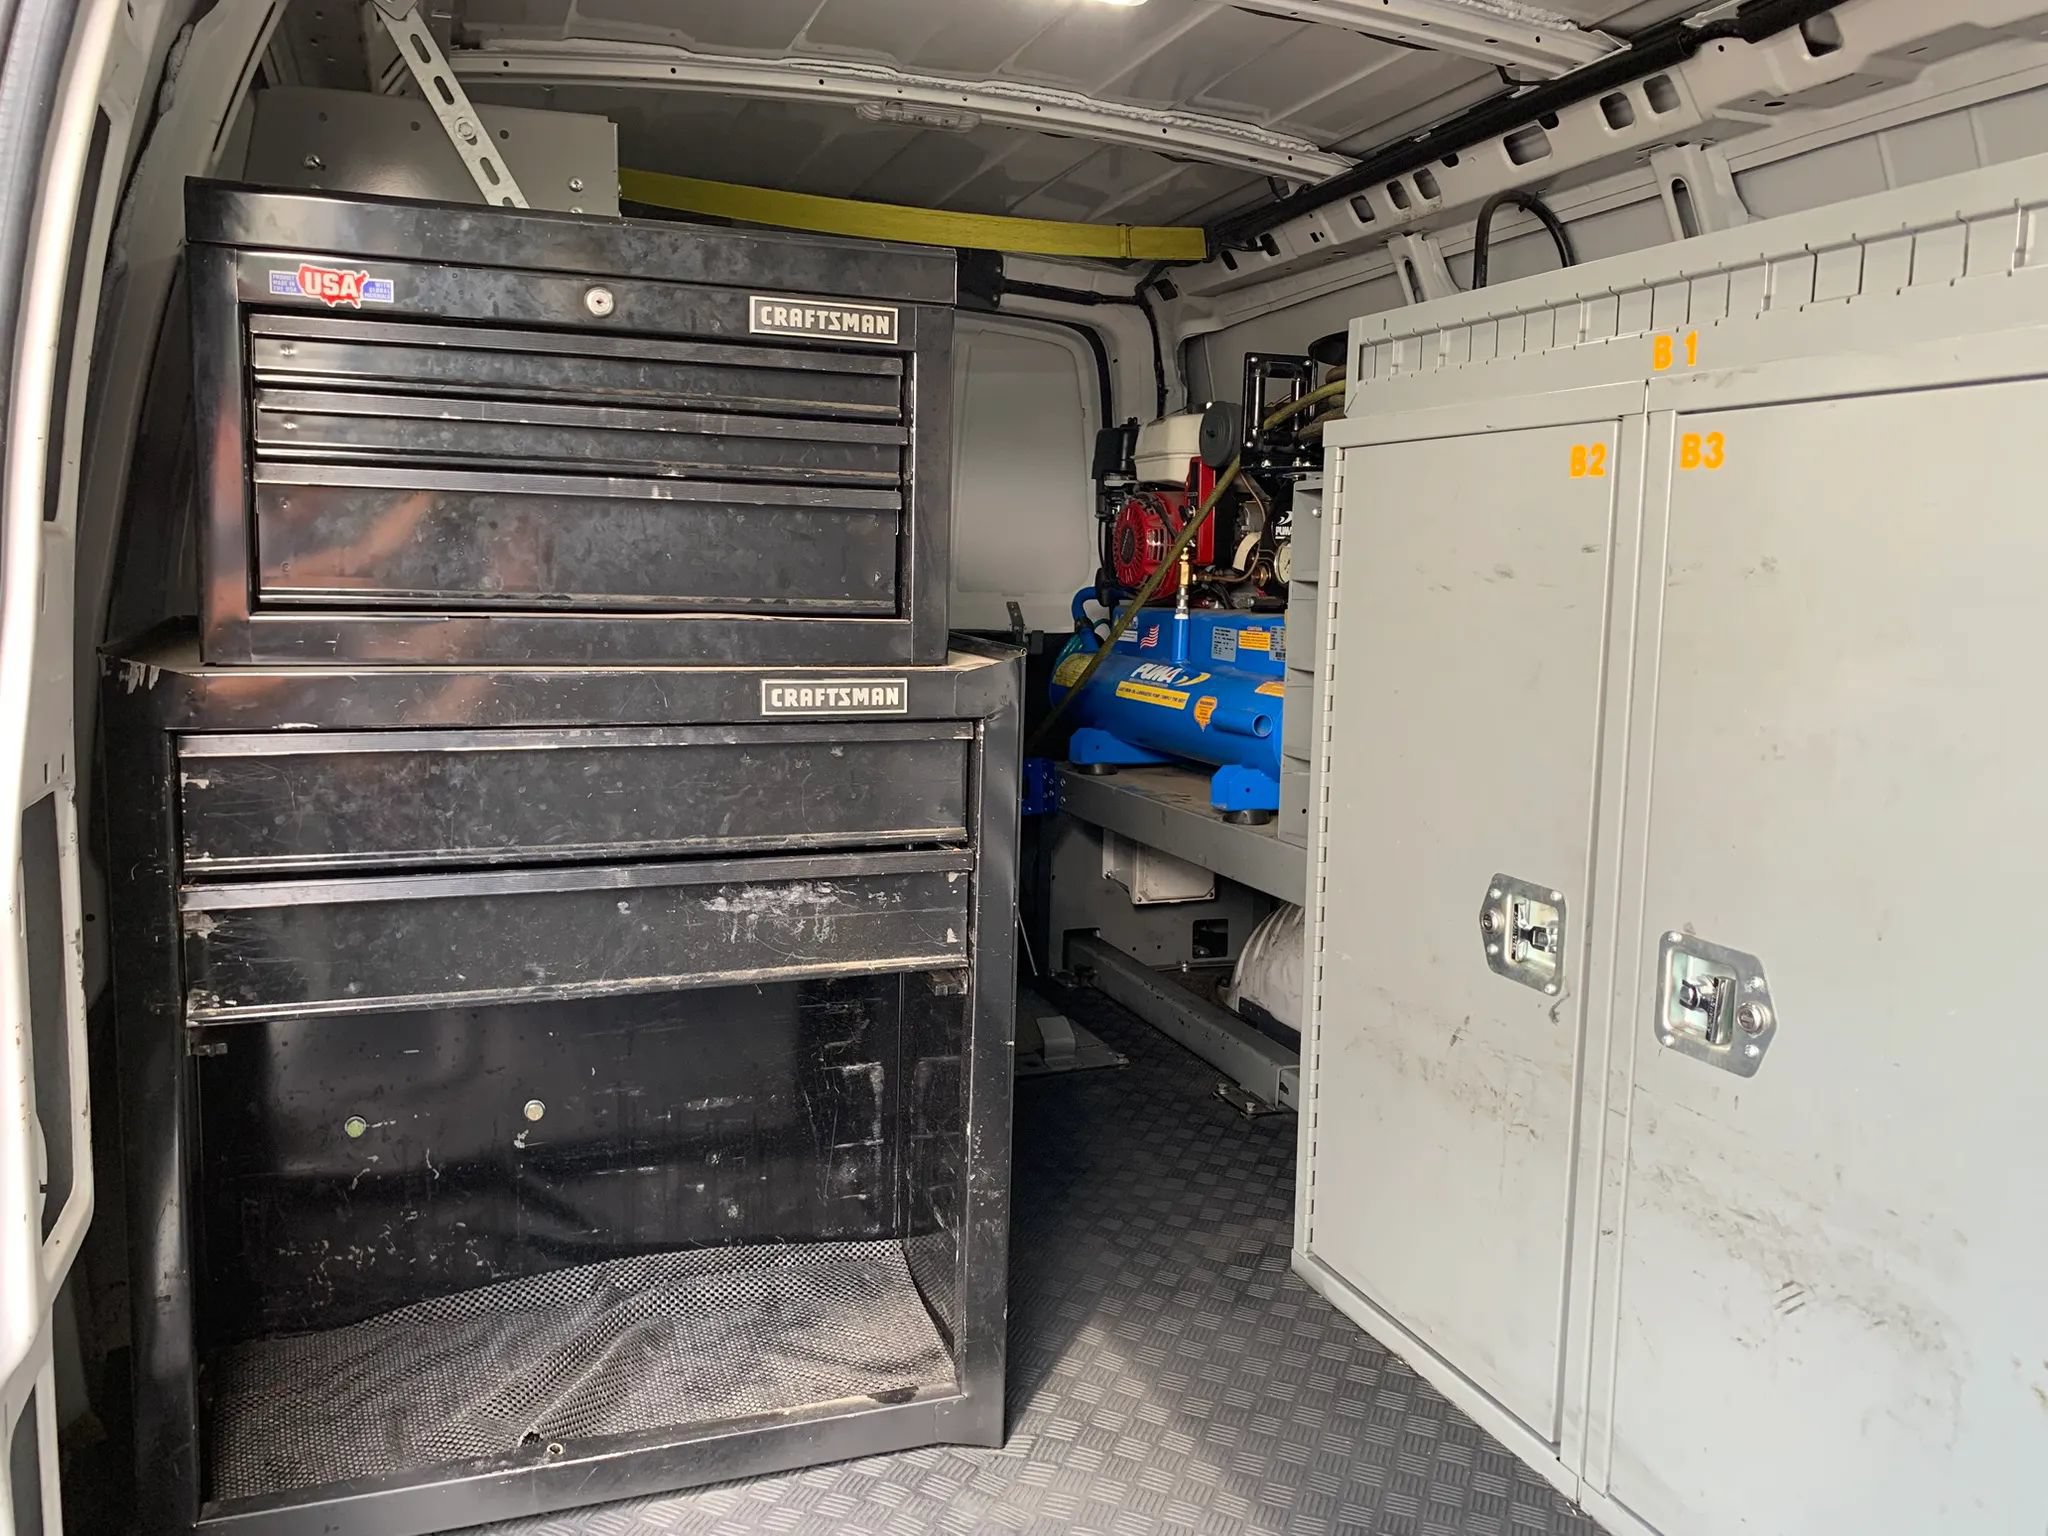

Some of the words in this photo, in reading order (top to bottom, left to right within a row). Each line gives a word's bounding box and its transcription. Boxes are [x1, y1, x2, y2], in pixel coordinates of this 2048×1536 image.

[304, 271, 360, 298] USA
[760, 306, 890, 335] CRAFTSMAN
[1569, 442, 1607, 479] B2
[1680, 431, 1725, 470] B3
[1130, 663, 1183, 683] PUMA
[771, 688, 899, 707] CRAFTSMAN
